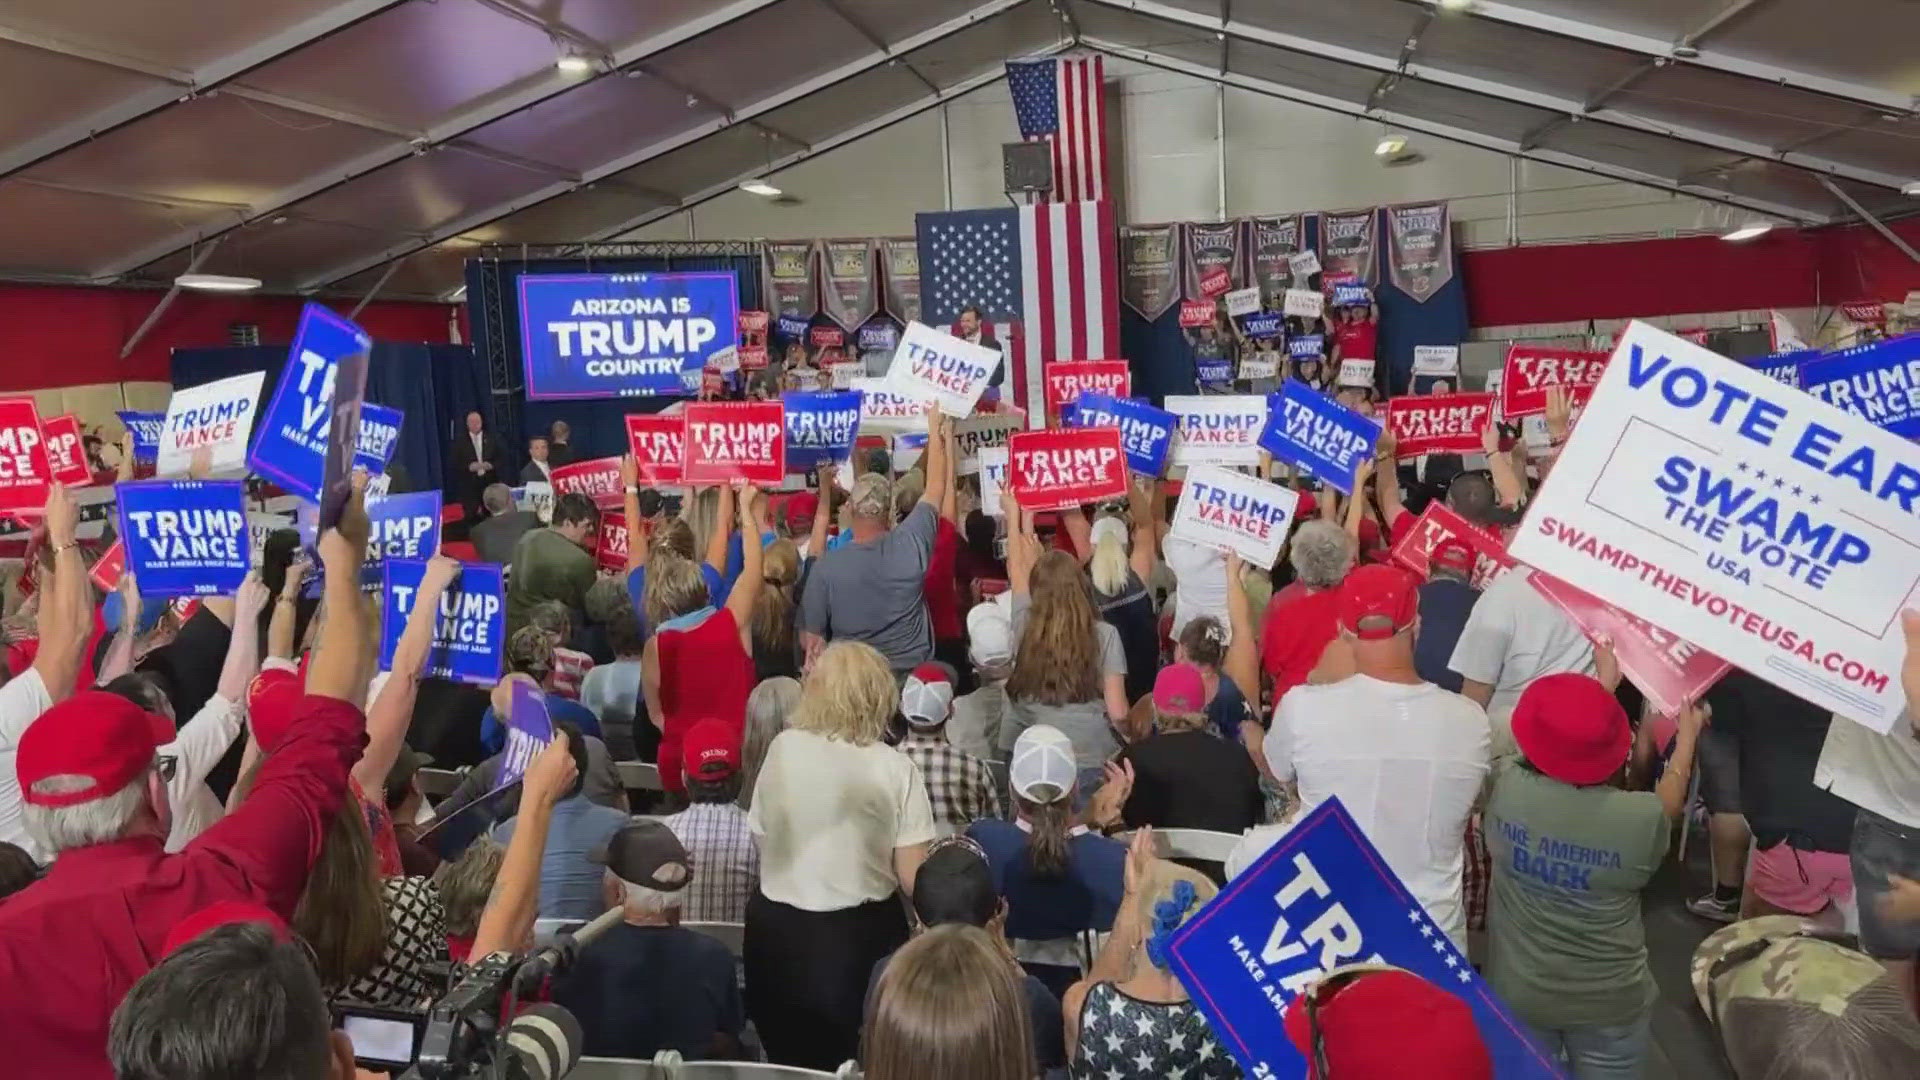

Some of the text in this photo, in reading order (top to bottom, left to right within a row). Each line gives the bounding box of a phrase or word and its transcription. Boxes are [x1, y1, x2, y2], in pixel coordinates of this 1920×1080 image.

[571, 296, 691, 316] ARIZONA IS
[547, 318, 716, 357] TRUMP
[585, 357, 685, 377] COUNTRY
[907, 341, 988, 382] TRUMP
[911, 362, 974, 394] VANCE
[1051, 373, 1125, 391] TRUMP
[863, 391, 912, 405] TRU
[171, 398, 250, 432] TRUMP
[785, 410, 858, 431] TRUMP
[1284, 397, 1369, 453] TRUMP
[1392, 404, 1488, 426] TRUMP
[1401, 420, 1474, 438] VANCE
[175, 421, 236, 449] VANCE
[358, 418, 397, 442] UMP
[635, 431, 685, 450] TRU
[690, 422, 781, 443] TRUMP
[795, 429, 851, 444] VANCE
[1181, 429, 1249, 444] VANCE
[1285, 419, 1352, 465] VANCE
[1626, 343, 1920, 518] VOTE EAR
[702, 442, 772, 459] VANCE
[1014, 447, 1117, 472] TRUMP
[556, 469, 620, 495] TRUMP
[1024, 465, 1107, 487] VANCE
[1192, 481, 1286, 525] TRUMP
[1654, 455, 1872, 570] SWAMP
[128, 509, 244, 539] TRUMP
[1199, 503, 1271, 539] VANCE
[149, 536, 240, 560] VANCE
[364, 539, 419, 560] NCE
[1662, 497, 1834, 590] THE VOTE
[1705, 551, 1752, 586] USA
[392, 584, 500, 622] TUMP
[1538, 515, 1891, 694] SWAMPTHEVOTEUSA.COM
[1650, 626, 1699, 665] CE
[1538, 837, 1621, 869] AMERICA
[1512, 848, 1592, 891] BACK
[1228, 935, 1266, 982] MAKE
